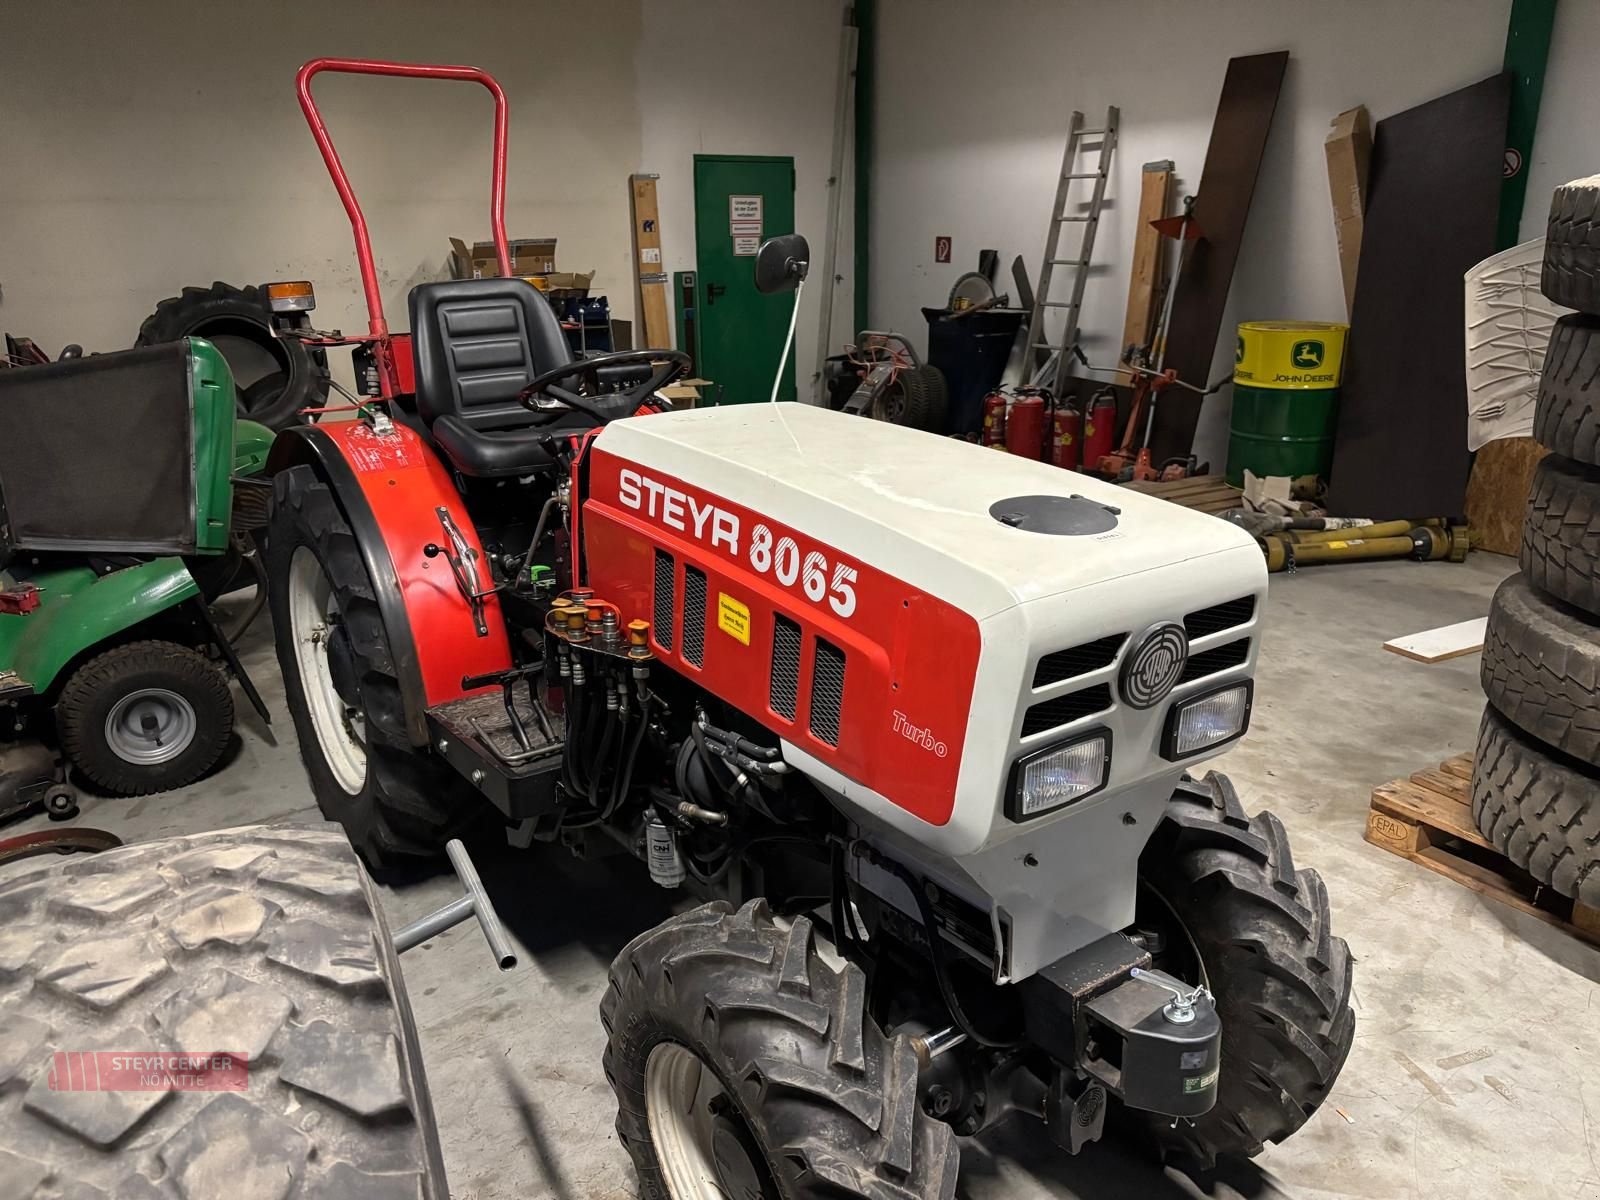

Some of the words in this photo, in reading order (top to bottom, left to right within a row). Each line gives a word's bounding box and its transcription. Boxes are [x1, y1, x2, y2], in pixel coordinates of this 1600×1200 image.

[1272, 373, 1302, 383] JOHN
[1303, 373, 1335, 382] DEERE
[619, 468, 740, 555] STEYR
[749, 523, 859, 618] 8065
[892, 709, 948, 758] Turbo
[1376, 817, 1402, 838] EPAL
